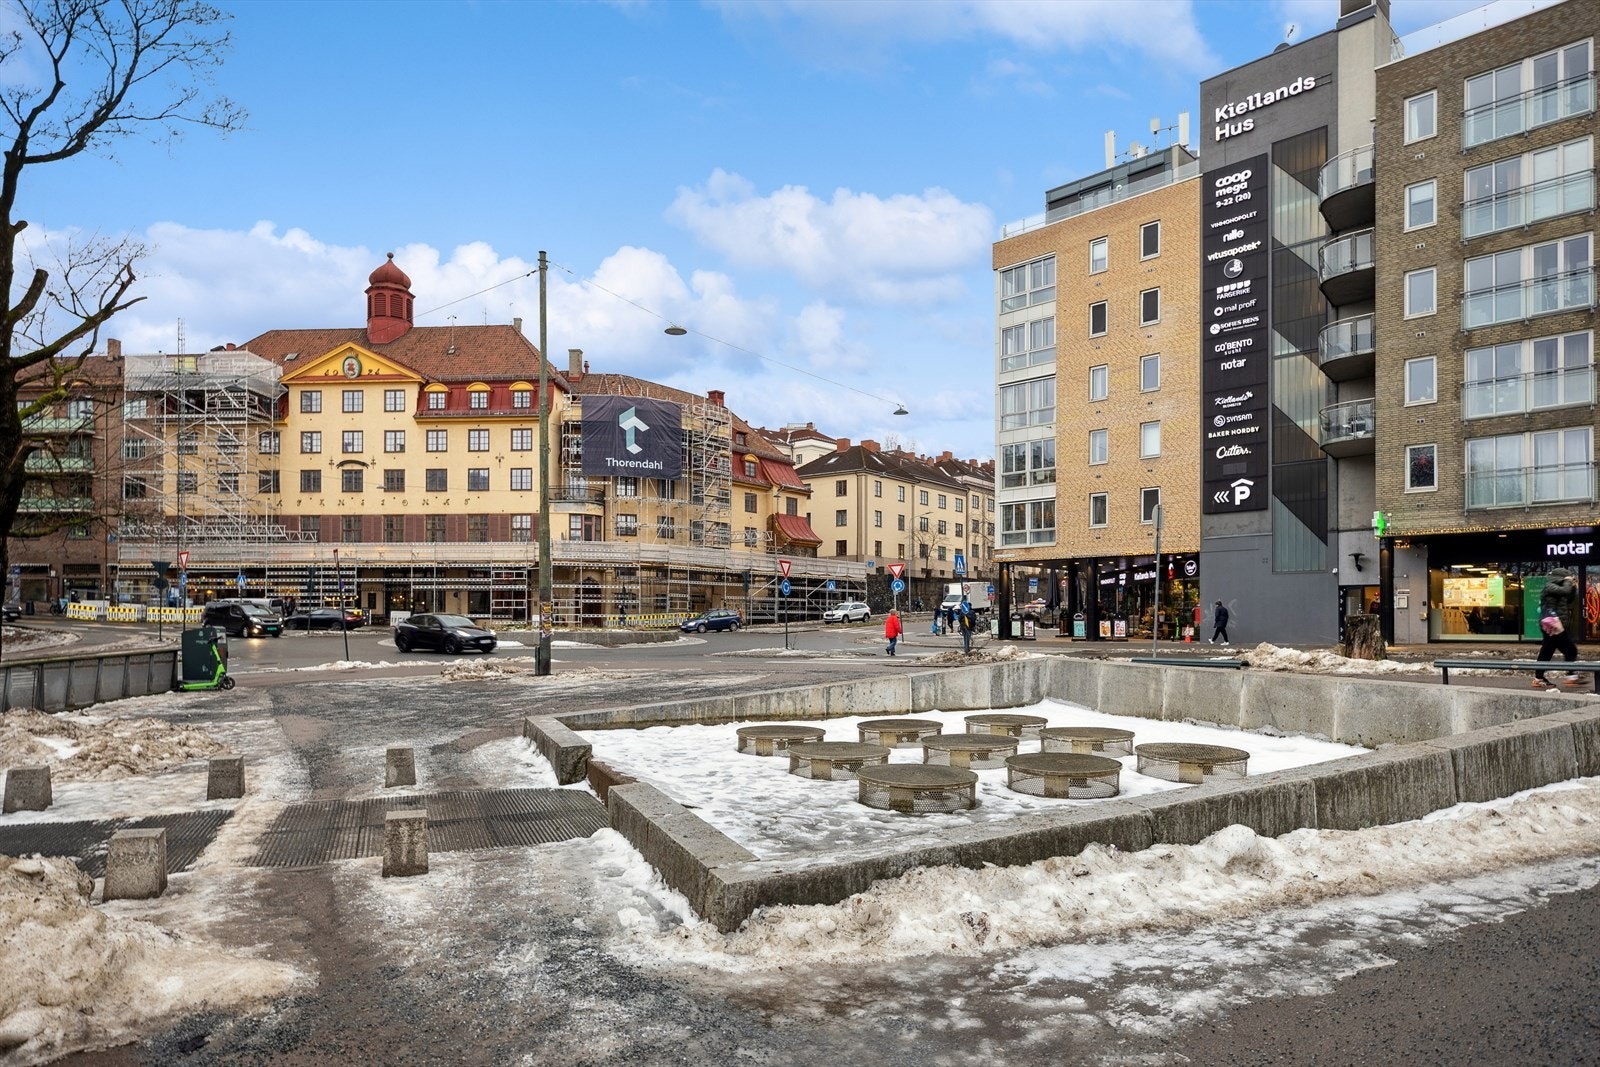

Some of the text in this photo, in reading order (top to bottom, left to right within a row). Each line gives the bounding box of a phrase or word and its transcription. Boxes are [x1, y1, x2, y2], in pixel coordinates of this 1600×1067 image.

[1215, 76, 1316, 122] Kiellands
[1215, 117, 1255, 141] Hus
[1215, 169, 1252, 188] coop
[1215, 181, 1248, 197] mega
[1215, 191, 1252, 208] 9-22 (20)
[1210, 210, 1258, 229] VINMONOPOLET
[1222, 229, 1245, 242] nille
[1216, 287, 1251, 300] FARGERIKE
[1224, 299, 1256, 313] mal proff
[1220, 319, 1242, 329] SOFIES
[1242, 316, 1260, 325] RENS
[1214, 338, 1253, 353] GO'BENTO
[1221, 358, 1247, 371] notar
[1208, 426, 1260, 438] BAKER NORDBY
[605, 457, 663, 470] Thorendahl
[1234, 485, 1251, 506] P
[1546, 540, 1594, 556] notar
